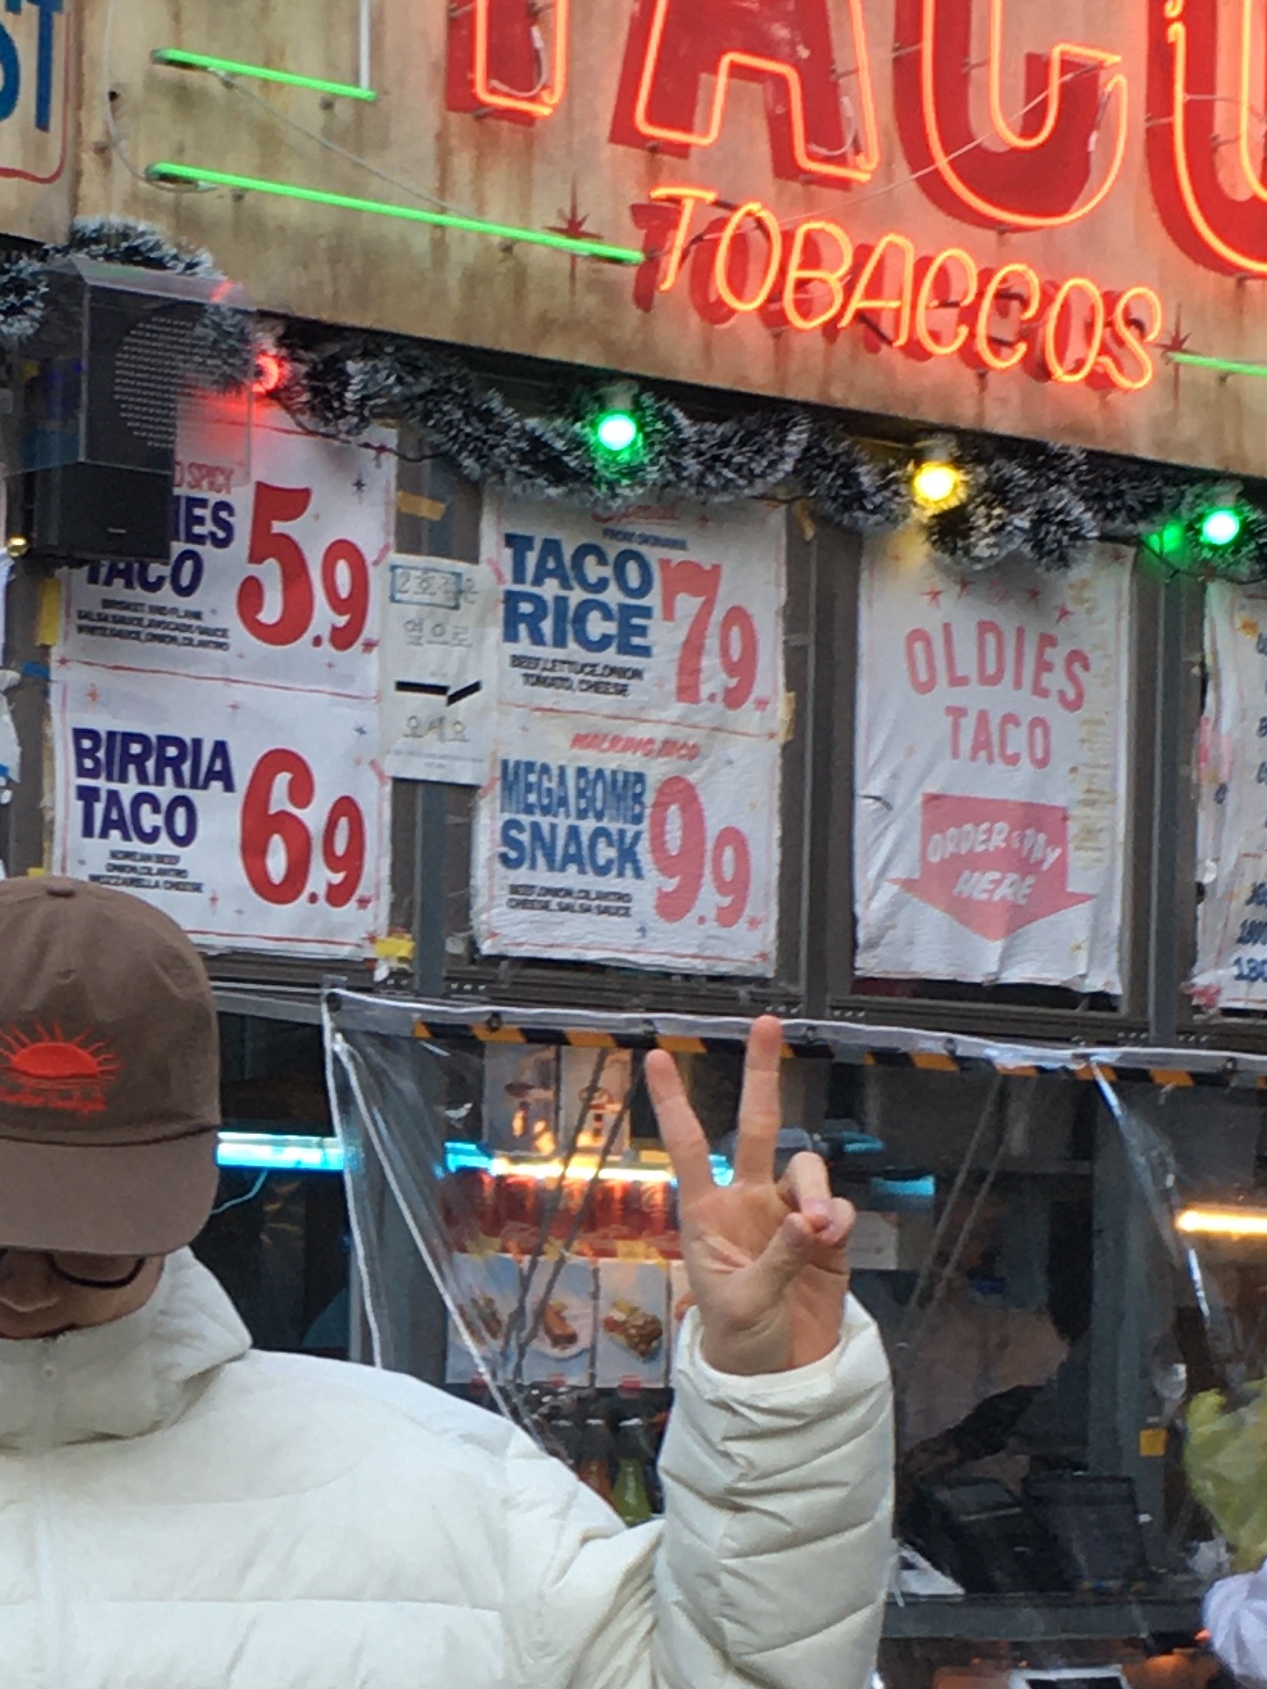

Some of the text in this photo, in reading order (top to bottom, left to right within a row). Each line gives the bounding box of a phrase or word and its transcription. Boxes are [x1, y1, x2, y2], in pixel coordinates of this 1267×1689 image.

[641, 185, 1165, 393] TOBACCOS
[504, 533, 654, 600] TACO
[502, 590, 654, 658] RICE
[904, 619, 1091, 714] OLDIES
[72, 727, 236, 793] BIRRIA
[944, 705, 1053, 770] TACO
[75, 785, 198, 848] TACO
[500, 759, 648, 825] MEGA BOMB
[498, 819, 646, 880] SNACK
[925, 820, 1010, 864] ORDER
[952, 868, 1037, 907] HERE
